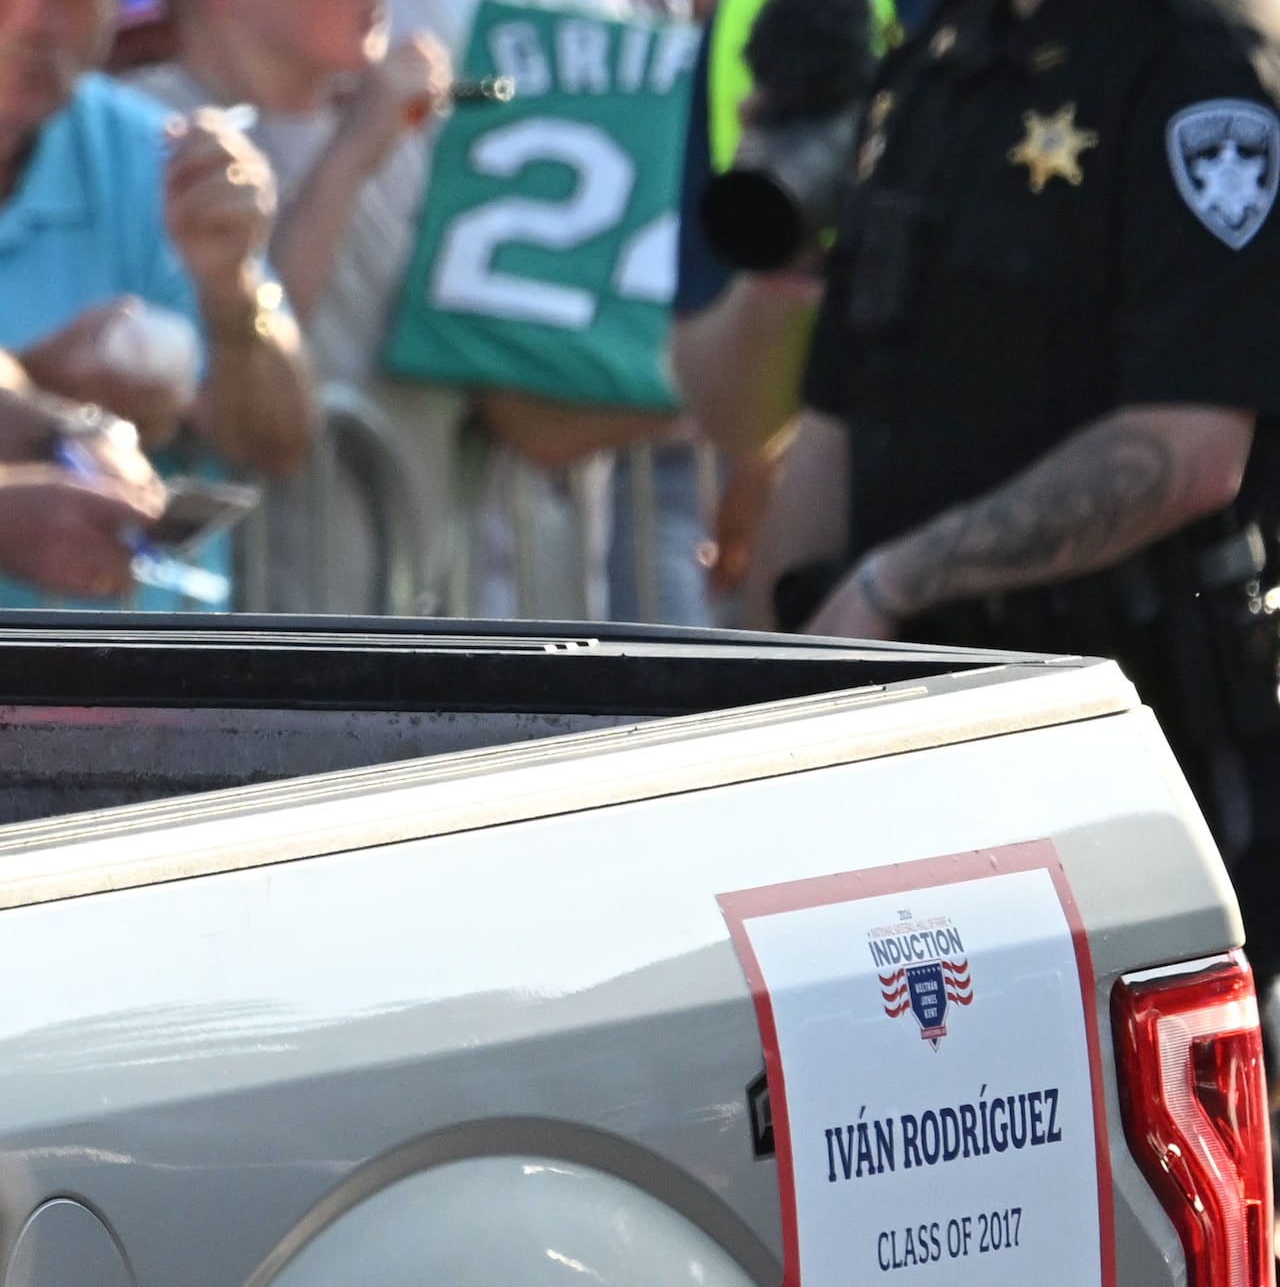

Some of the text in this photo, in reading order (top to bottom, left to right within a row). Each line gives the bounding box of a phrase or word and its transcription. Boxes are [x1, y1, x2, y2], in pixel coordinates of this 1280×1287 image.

[868, 927, 964, 968] INDUCTION
[924, 1008, 938, 1019] KENT
[825, 1084, 1062, 1182] IVÁN RODRÍGUEZ
[878, 1207, 1022, 1271] CLASS OF 2017
